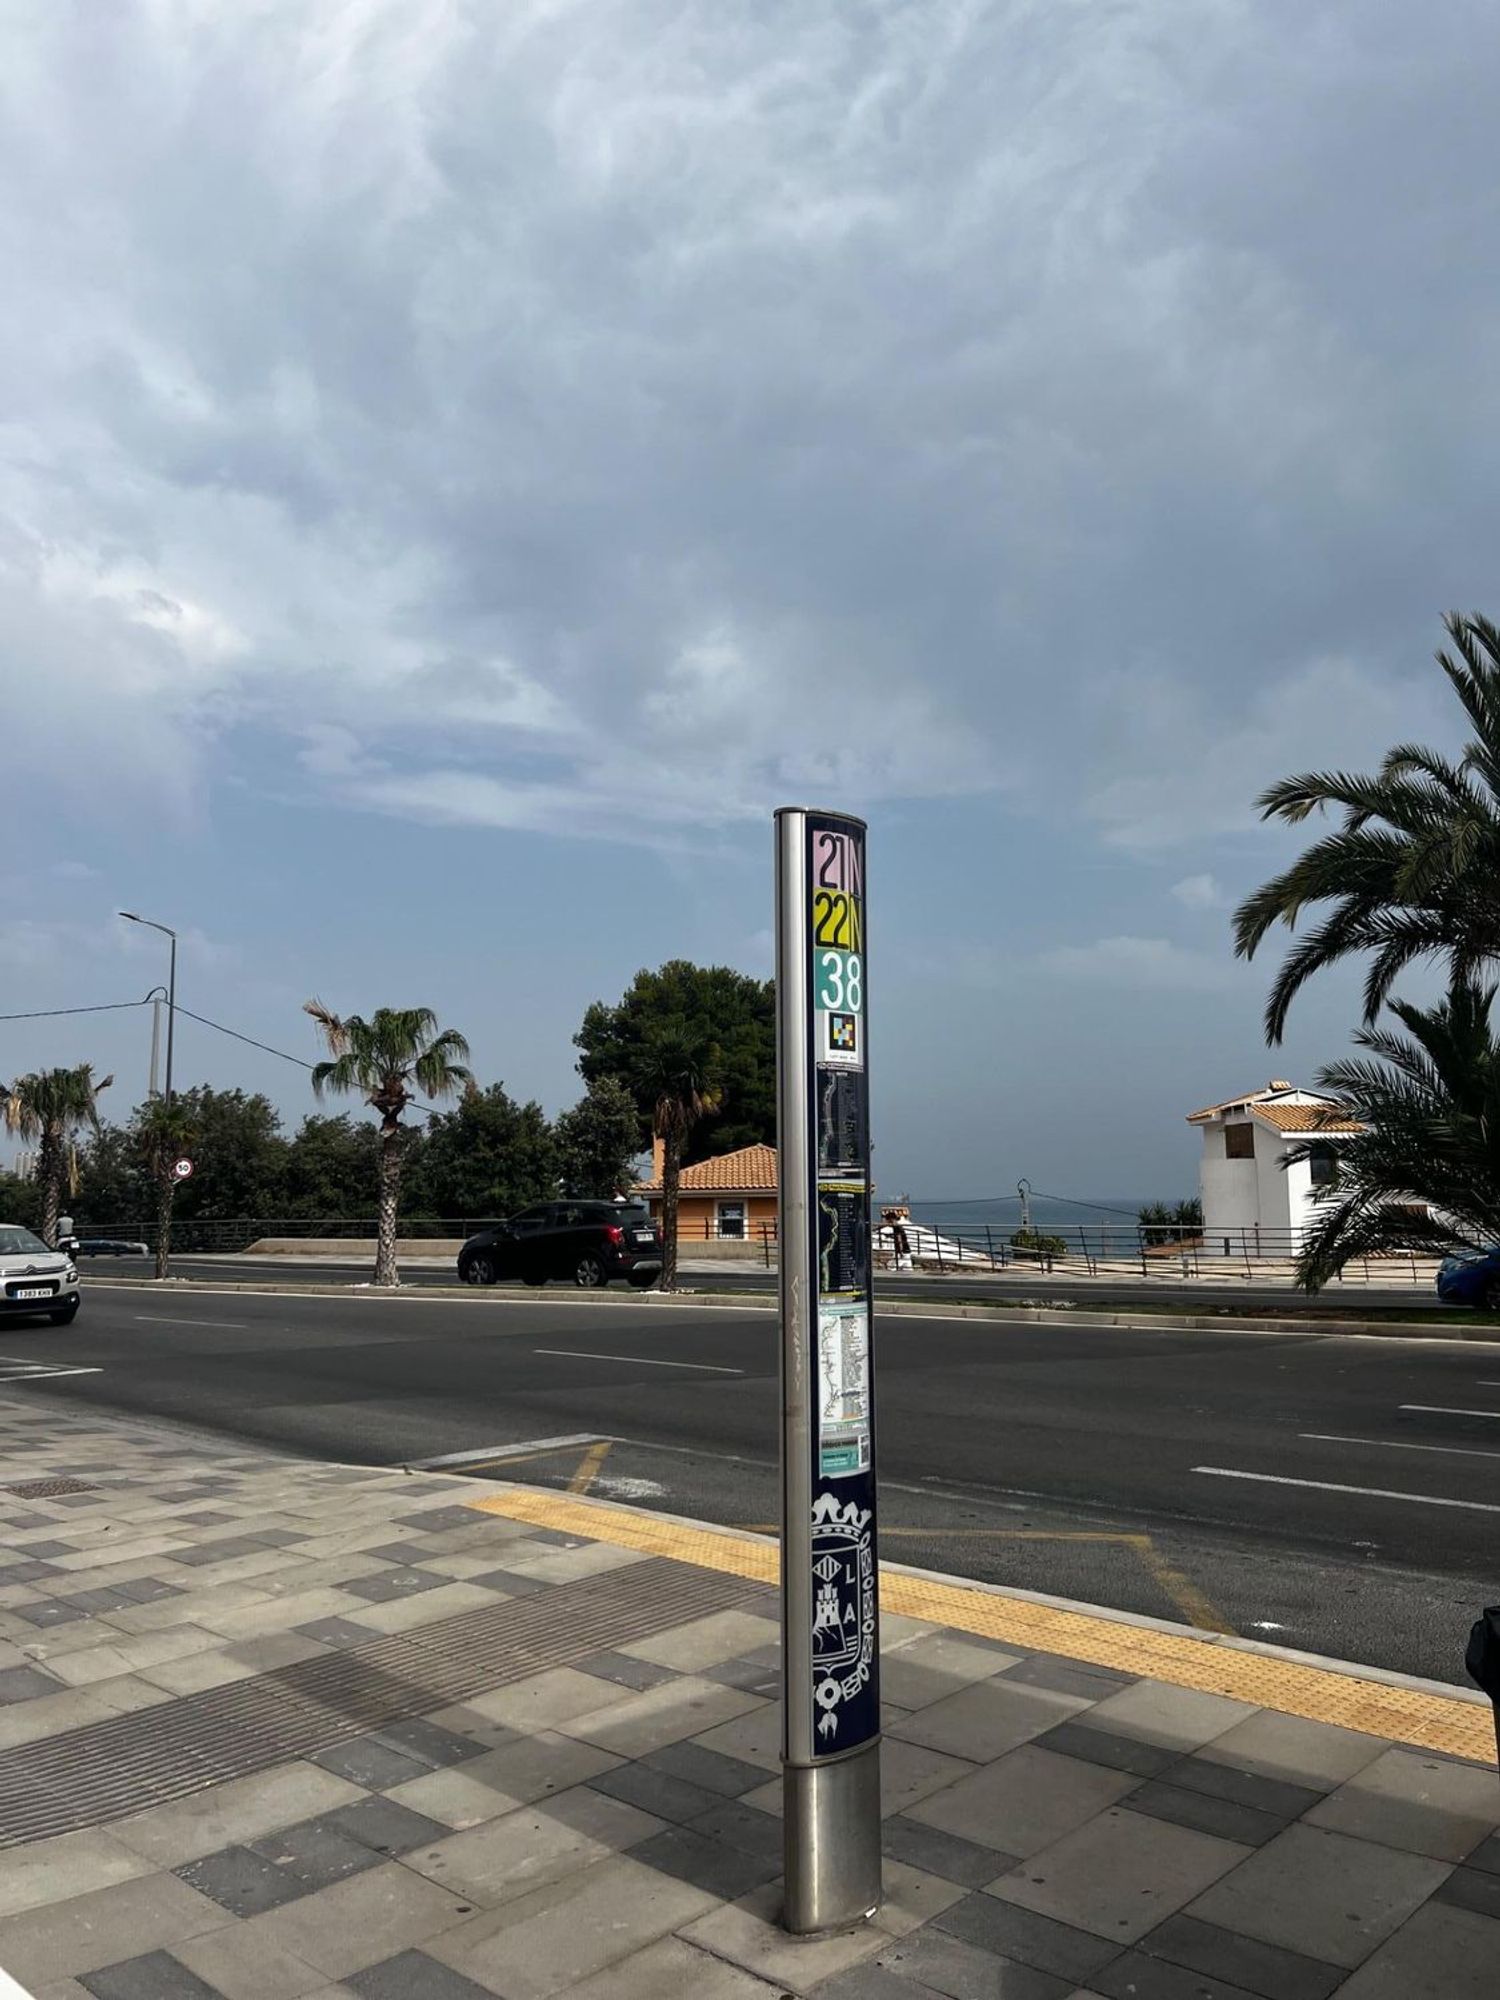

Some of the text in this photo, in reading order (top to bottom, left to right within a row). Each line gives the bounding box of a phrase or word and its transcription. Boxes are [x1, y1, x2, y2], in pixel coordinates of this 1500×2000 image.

[818, 833, 861, 895] 21N
[815, 891, 862, 953] 22N
[821, 951, 862, 1012] 38
[178, 1164, 189, 1172] 50
[846, 1564, 855, 1583] L
[843, 1603, 856, 1623] A
